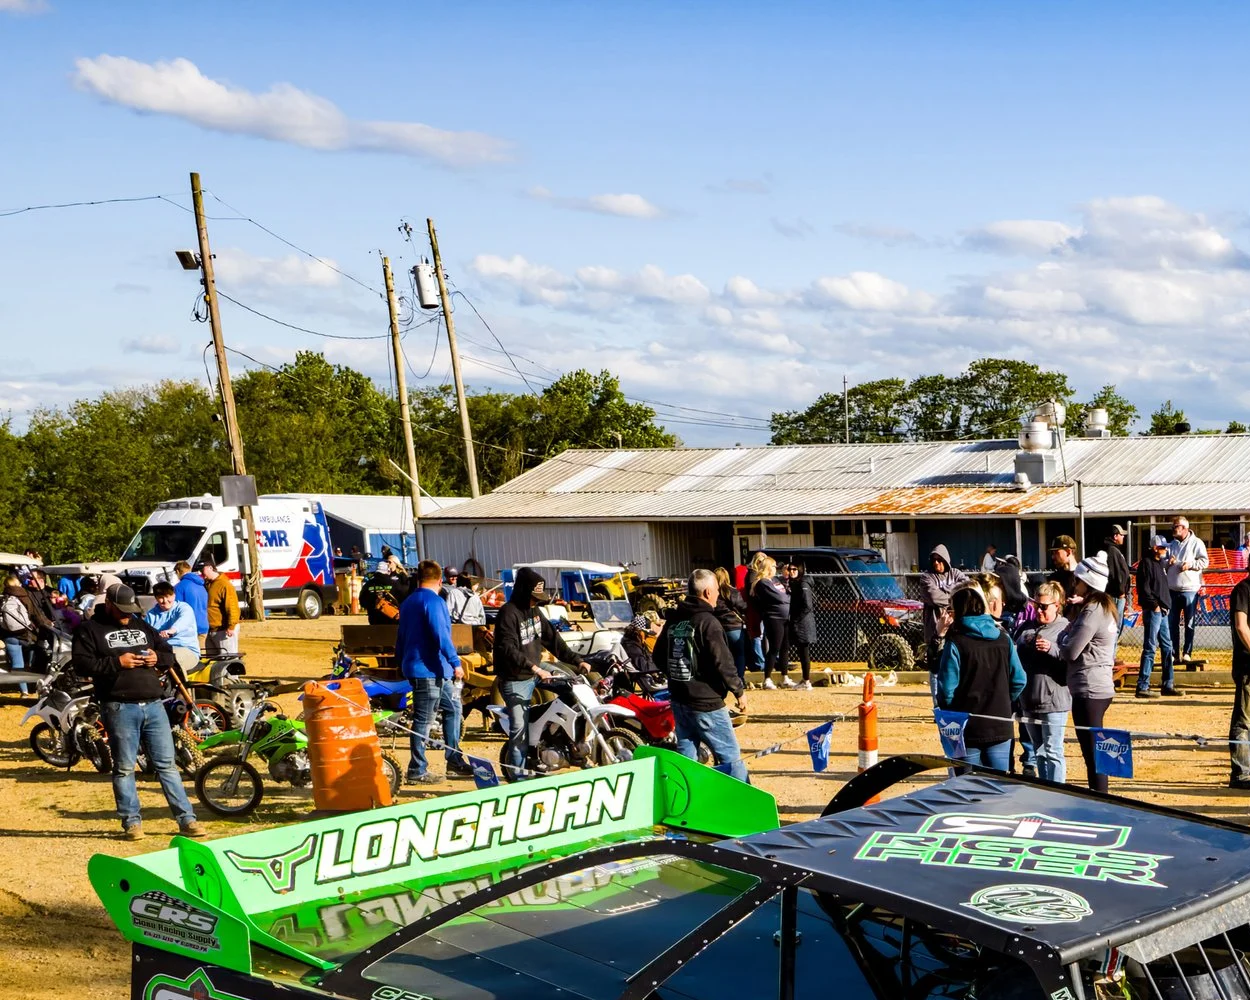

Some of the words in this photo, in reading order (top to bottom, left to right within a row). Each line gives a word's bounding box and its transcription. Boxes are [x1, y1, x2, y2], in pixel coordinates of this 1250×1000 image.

[314, 772, 635, 884] LONGHORN
[855, 846, 1167, 887] FIBER
[872, 832, 1165, 868] RIGGS
[131, 898, 215, 931] CRS
